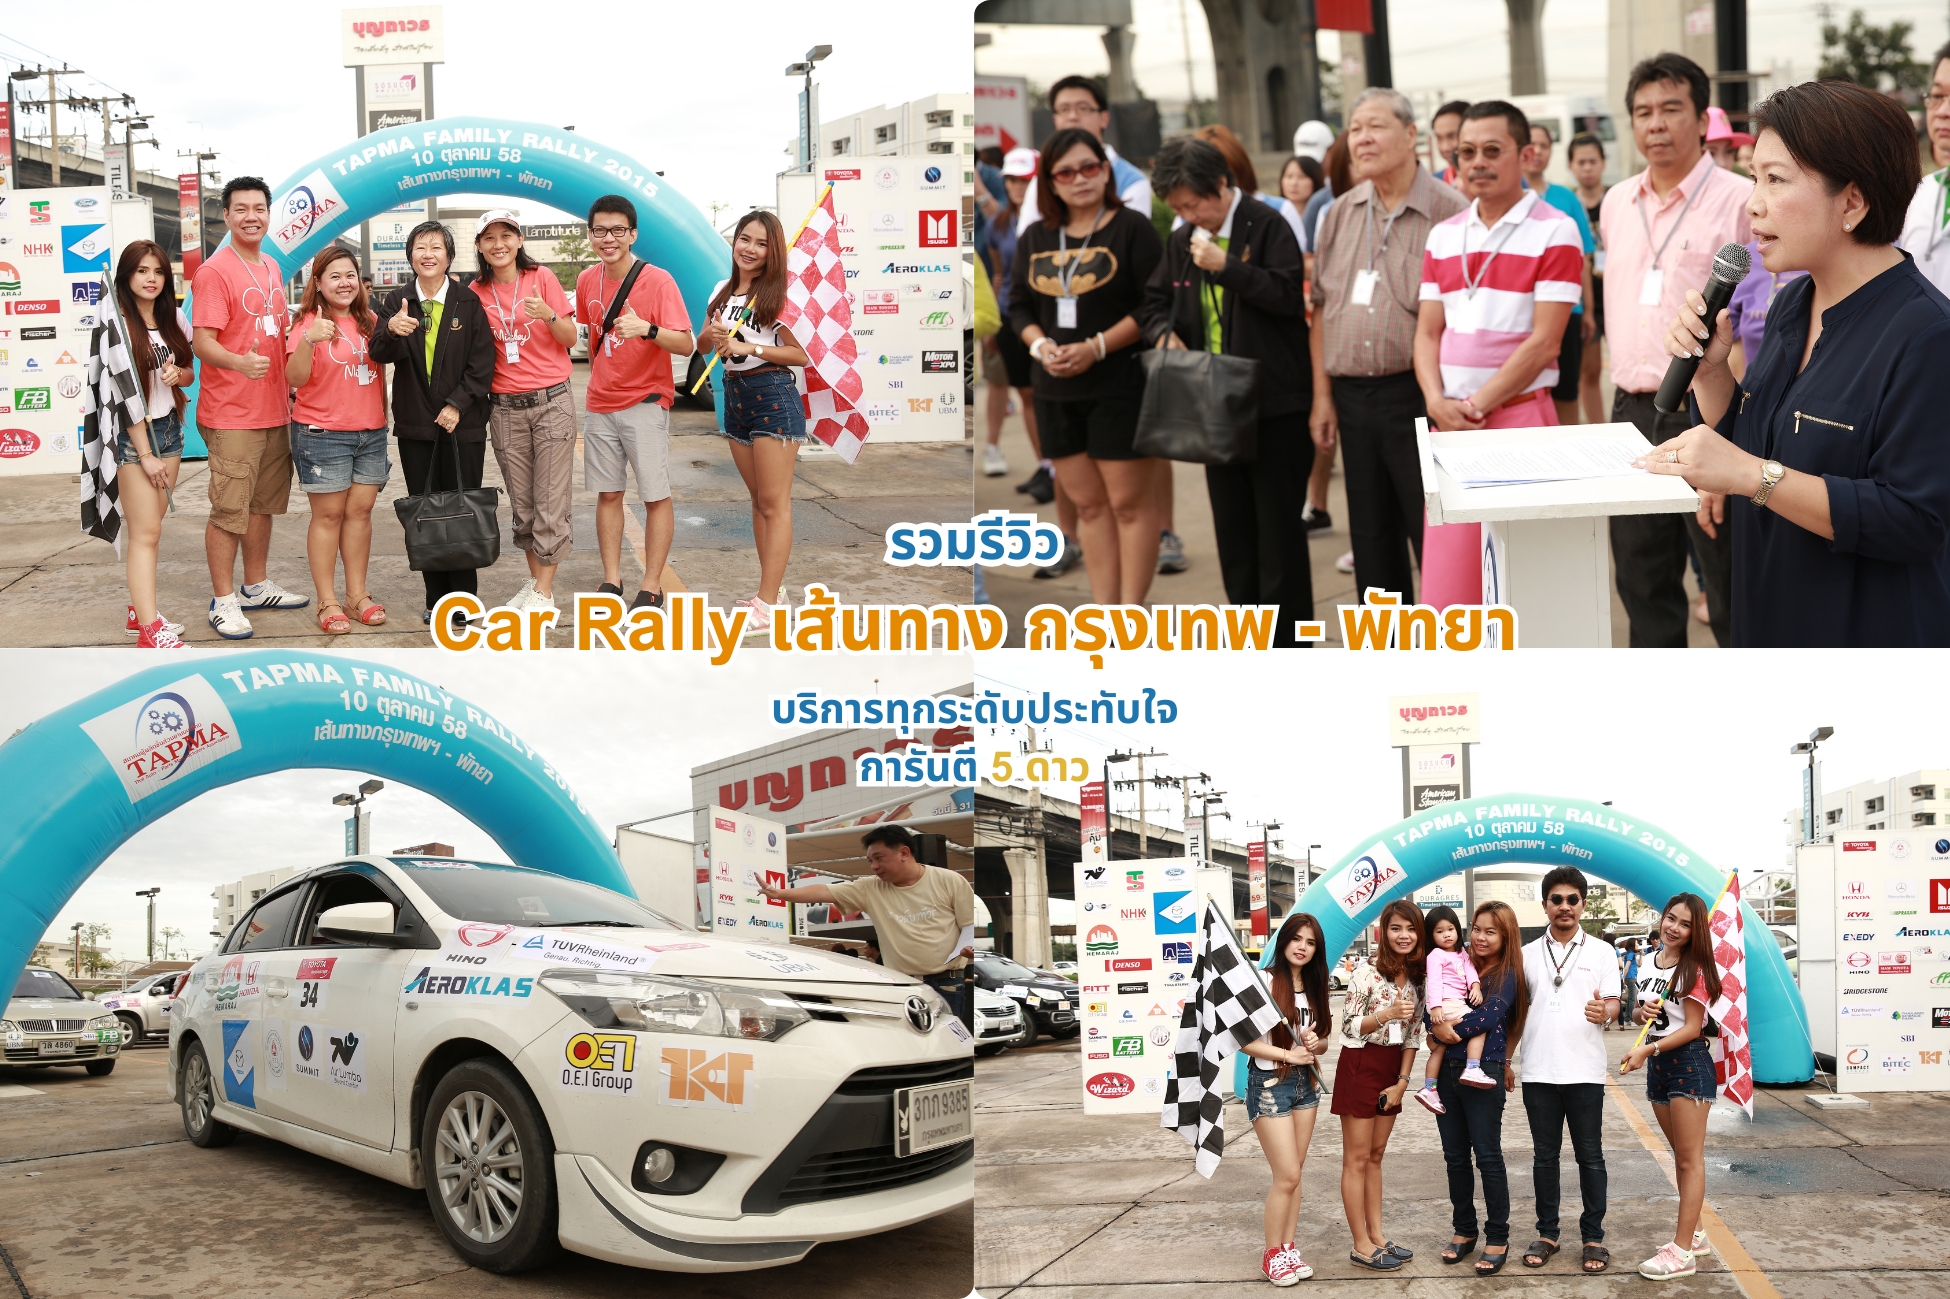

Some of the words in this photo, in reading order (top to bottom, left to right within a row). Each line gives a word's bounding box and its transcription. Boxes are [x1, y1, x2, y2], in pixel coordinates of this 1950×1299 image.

[352, 19, 430, 38] บุญถาวร
[377, 113, 417, 125] American
[332, 136, 416, 176] TAPMA
[423, 127, 513, 147] FAMILY
[522, 132, 599, 164] RALLY
[603, 158, 659, 198] 2015
[412, 151, 434, 167] 10
[441, 147, 491, 166] ตุลาคม
[497, 148, 522, 164] 58
[518, 170, 553, 191] พัทยา
[278, 198, 337, 242] TAPMA
[526, 225, 580, 238] Lamptitude
[24, 243, 52, 255] NHK
[881, 262, 951, 274] AEROKLAS
[17, 303, 47, 311] DENSO
[926, 311, 949, 325] FPI
[924, 351, 954, 362] MOTOR
[344, 364, 378, 384] Miey
[888, 381, 904, 389] SBI
[20, 390, 48, 405] FB
[868, 409, 900, 417] BITEC
[938, 407, 958, 415] UBM
[221, 662, 345, 693] TAPMA
[351, 667, 454, 711] FAMILY
[465, 705, 535, 761] RALLY
[340, 689, 368, 711] 10
[377, 695, 434, 727] ตุลาคม
[441, 715, 468, 739] 58
[1399, 704, 1468, 722] บุญถาวร
[127, 723, 228, 779] TAPMA
[314, 718, 441, 756] เส้นทางกรุงเทพฯ
[456, 752, 493, 785] พัทยา
[1420, 788, 1457, 799] American
[932, 801, 951, 816] วันนี้
[960, 801, 971, 810] 31
[1393, 811, 1468, 848] TAPMA
[1475, 803, 1557, 821] FAMILY
[1565, 808, 1635, 836] RALLY
[1638, 831, 1690, 867] 2015
[1464, 823, 1485, 839] 10
[1491, 821, 1537, 838] ตุลาคม
[1542, 822, 1565, 836] 58
[1561, 841, 1593, 861] พัทยา
[1344, 866, 1397, 907] TAPMA
[1121, 908, 1146, 919] NHK
[717, 916, 737, 927] EXEDY
[748, 915, 784, 929] AEROKLAS
[1843, 933, 1875, 941] EXEDY
[1895, 926, 1950, 937] AEROKLA
[307, 960, 327, 968] TOYOTA
[446, 953, 487, 965] HINO
[543, 951, 570, 963] Genau.
[571, 956, 602, 969] Richtig.
[1115, 961, 1141, 969] DENSO
[770, 962, 820, 974] UBM
[404, 966, 534, 998] AEROKLAS
[238, 987, 260, 998] HONDA
[300, 981, 318, 1008] 34
[1843, 987, 1888, 995] BRIDGESTONE
[214, 1001, 237, 1011] HEMARAJ
[102, 1030, 118, 1040] FB
[54, 1041, 74, 1049] 4860
[1117, 1038, 1142, 1052] FB
[296, 1063, 320, 1077] SUMMIT
[592, 1071, 633, 1094] Group
[942, 1088, 968, 1117] 9385
